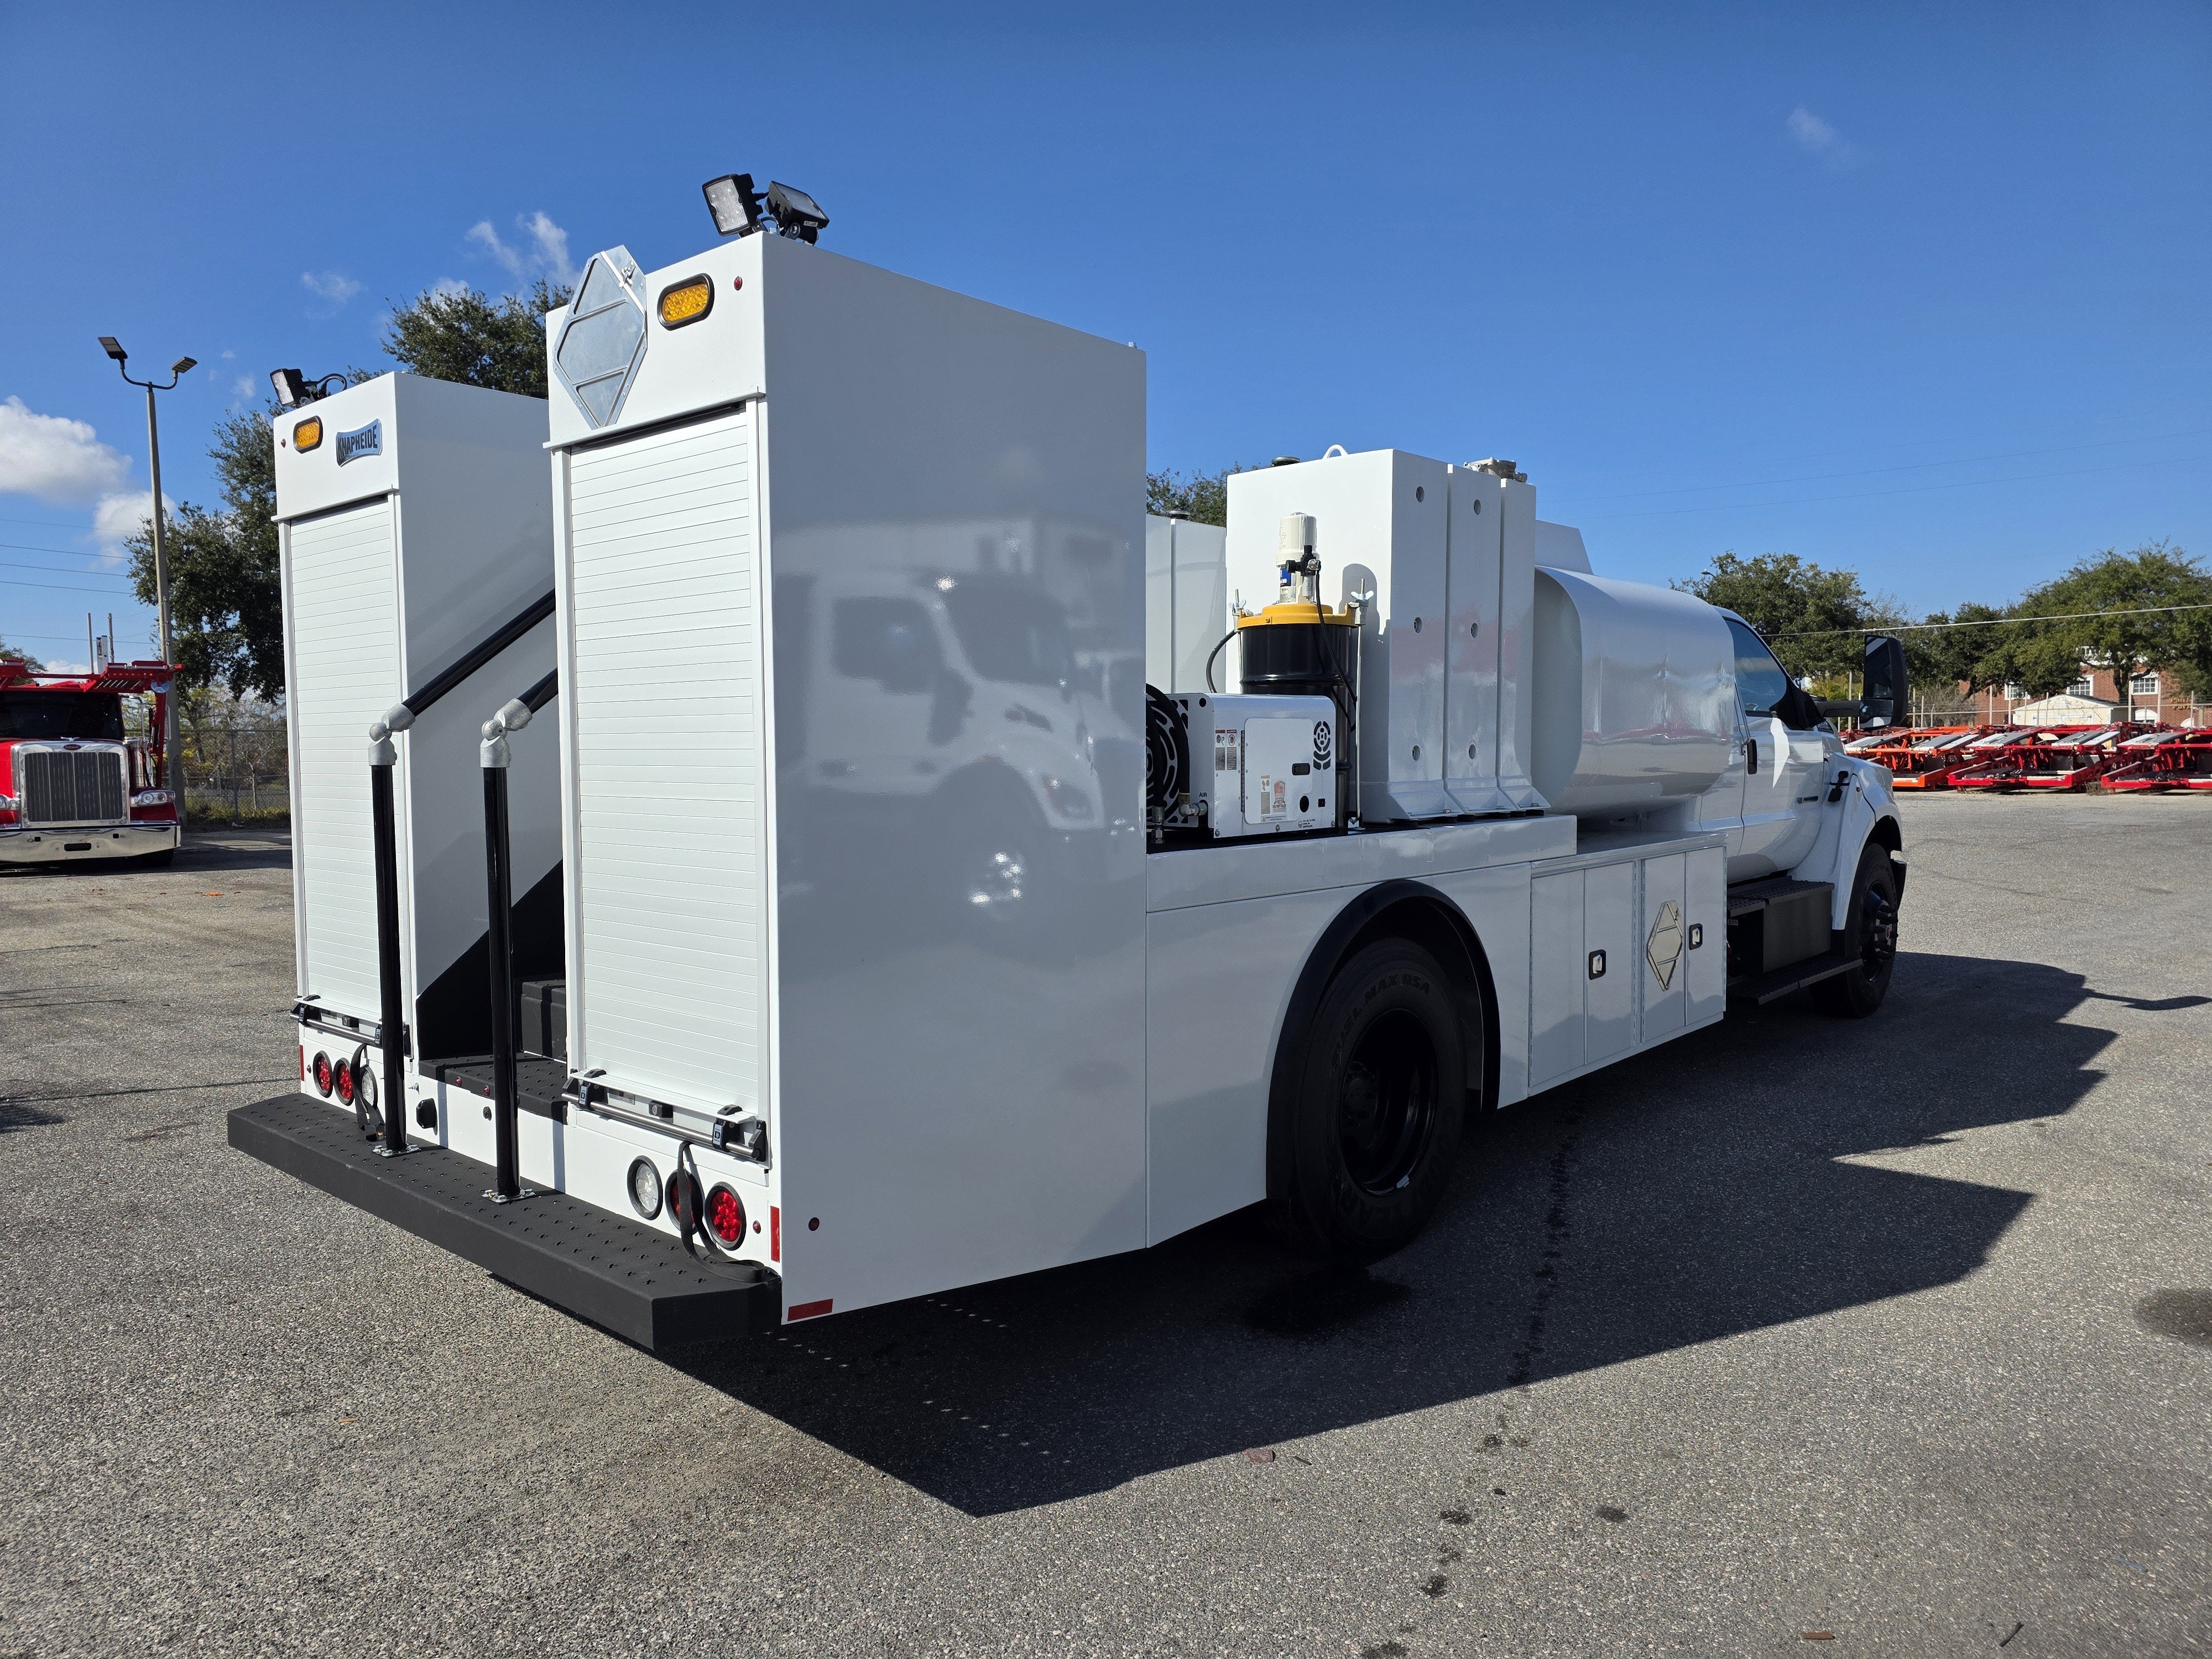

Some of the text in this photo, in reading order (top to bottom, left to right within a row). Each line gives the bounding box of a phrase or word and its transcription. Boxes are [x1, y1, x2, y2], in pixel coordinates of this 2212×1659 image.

[337, 425, 378, 461] KNAPHEIDE
[1331, 973, 1431, 1071] FUEL MAX RSA
